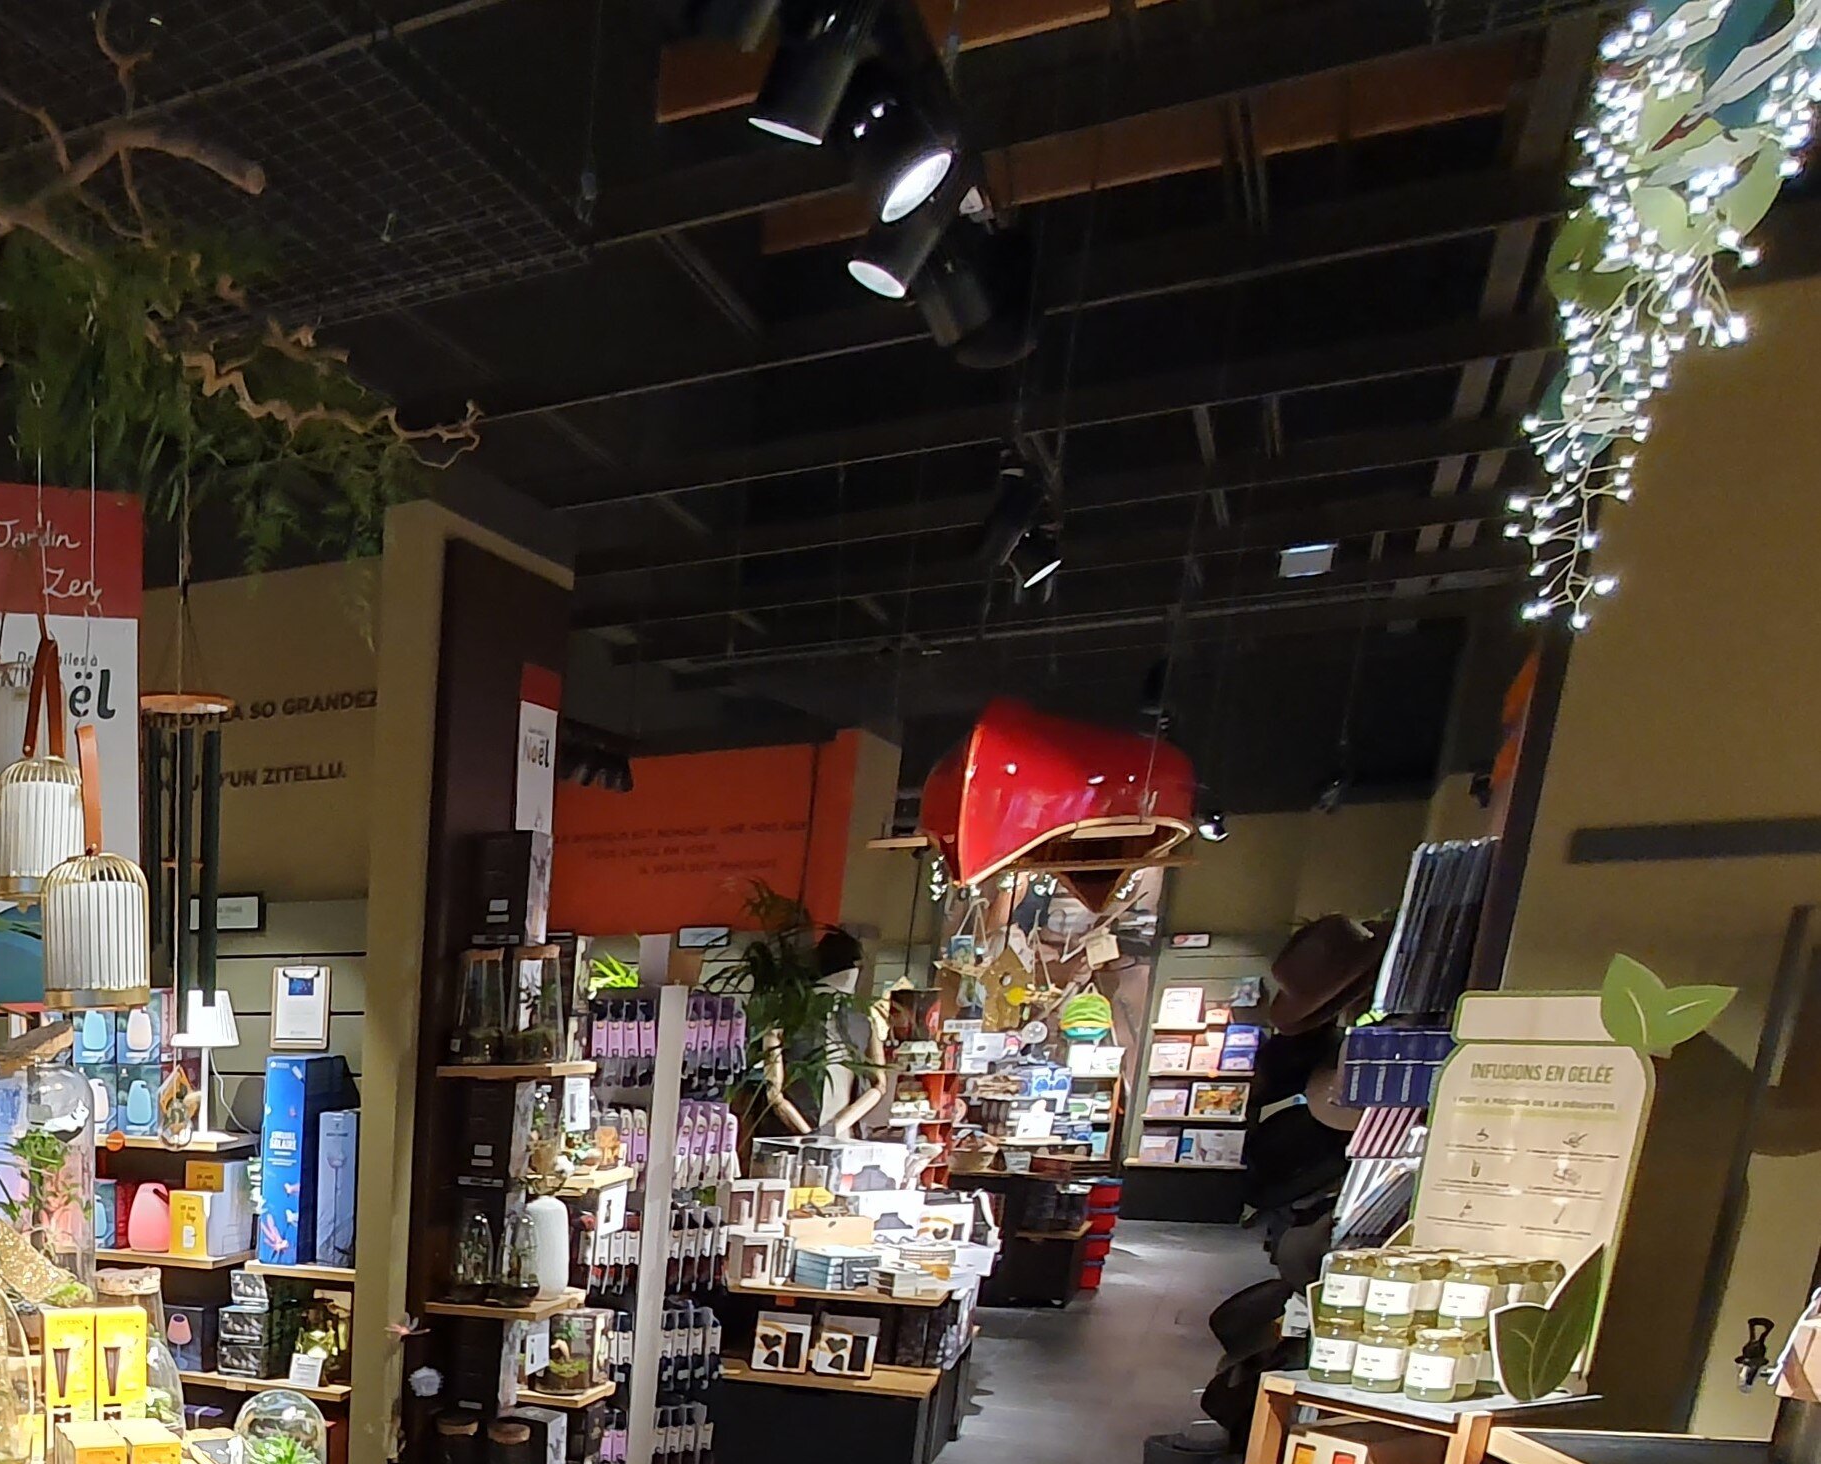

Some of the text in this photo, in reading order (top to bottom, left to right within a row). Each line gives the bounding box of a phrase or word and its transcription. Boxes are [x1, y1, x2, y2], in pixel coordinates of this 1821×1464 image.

[42, 567, 103, 604] Zen
[90, 654, 98, 667] à
[250, 701, 275, 720] SO
[263, 761, 347, 785] ZITELLU.
[1470, 1062, 1614, 1084] INFUSIONS EN GELÉE
